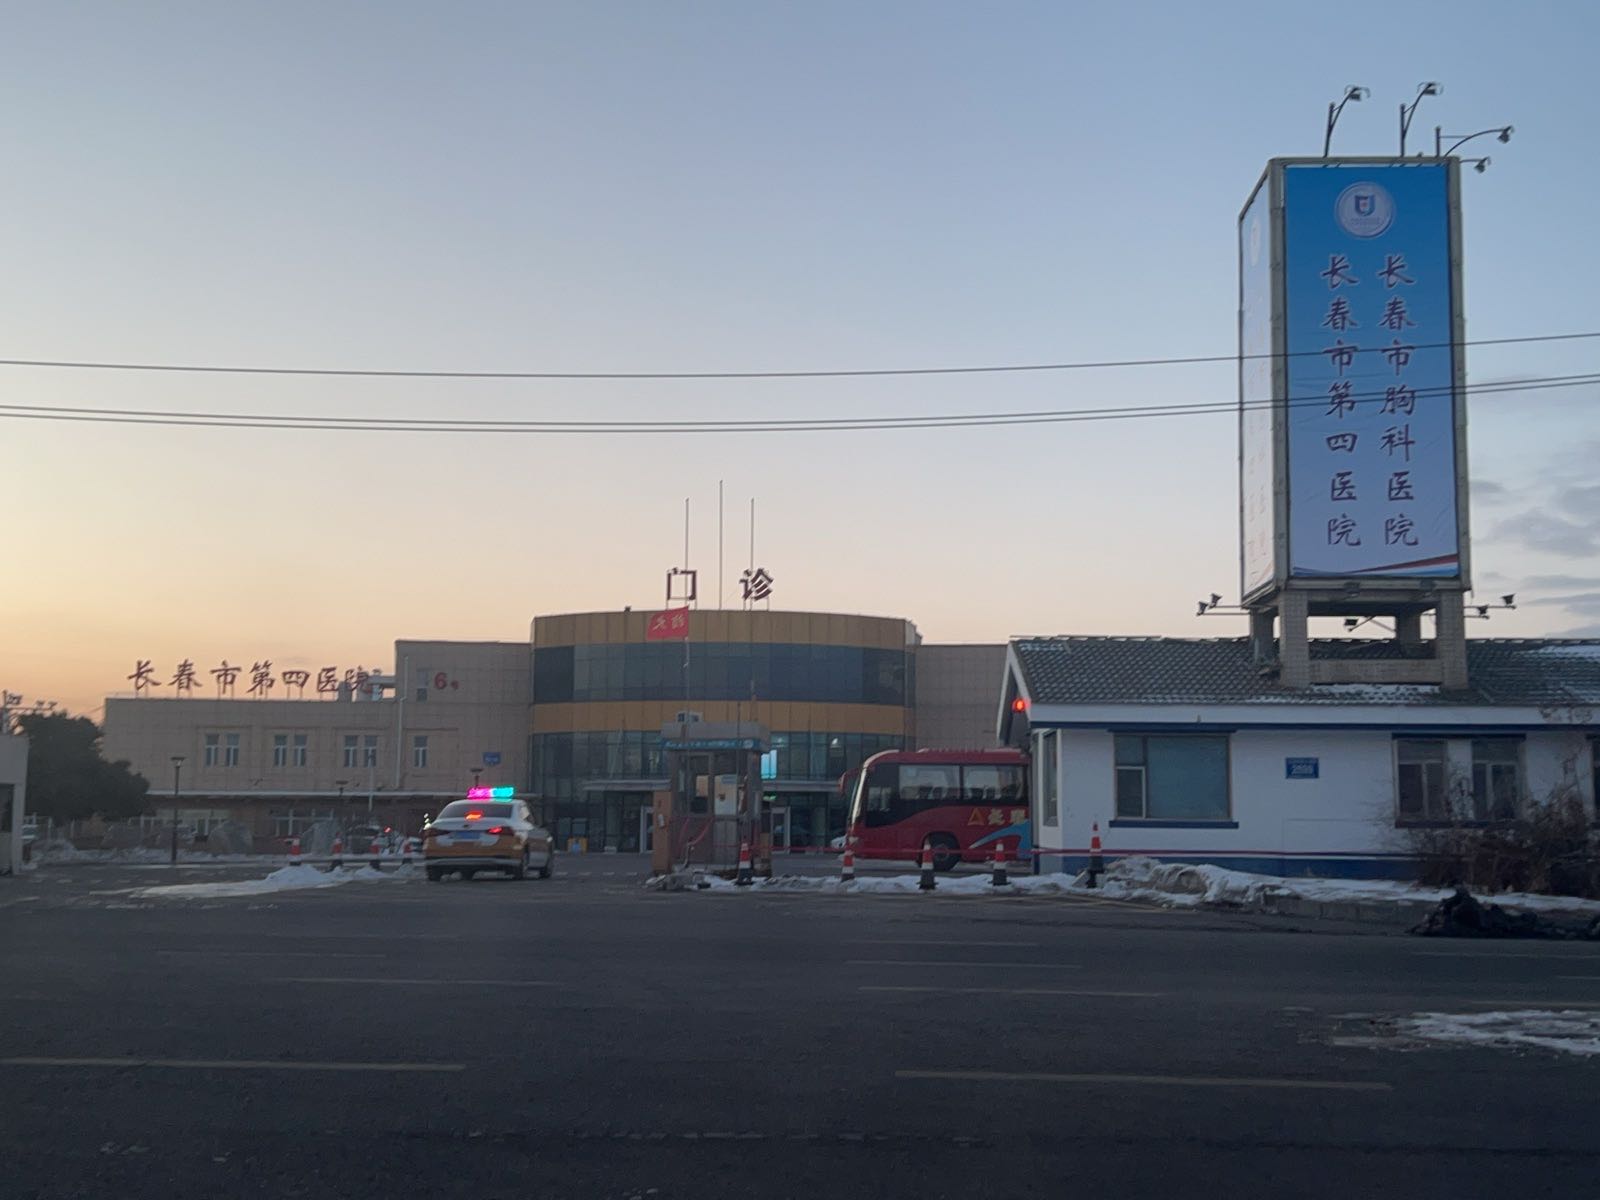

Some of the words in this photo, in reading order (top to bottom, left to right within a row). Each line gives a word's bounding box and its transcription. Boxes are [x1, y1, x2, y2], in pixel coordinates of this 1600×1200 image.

[1321, 253, 1361, 547] 长春市第四医院
[1377, 253, 1419, 547] 长春市胸科医院
[666, 567, 775, 602] 门诊
